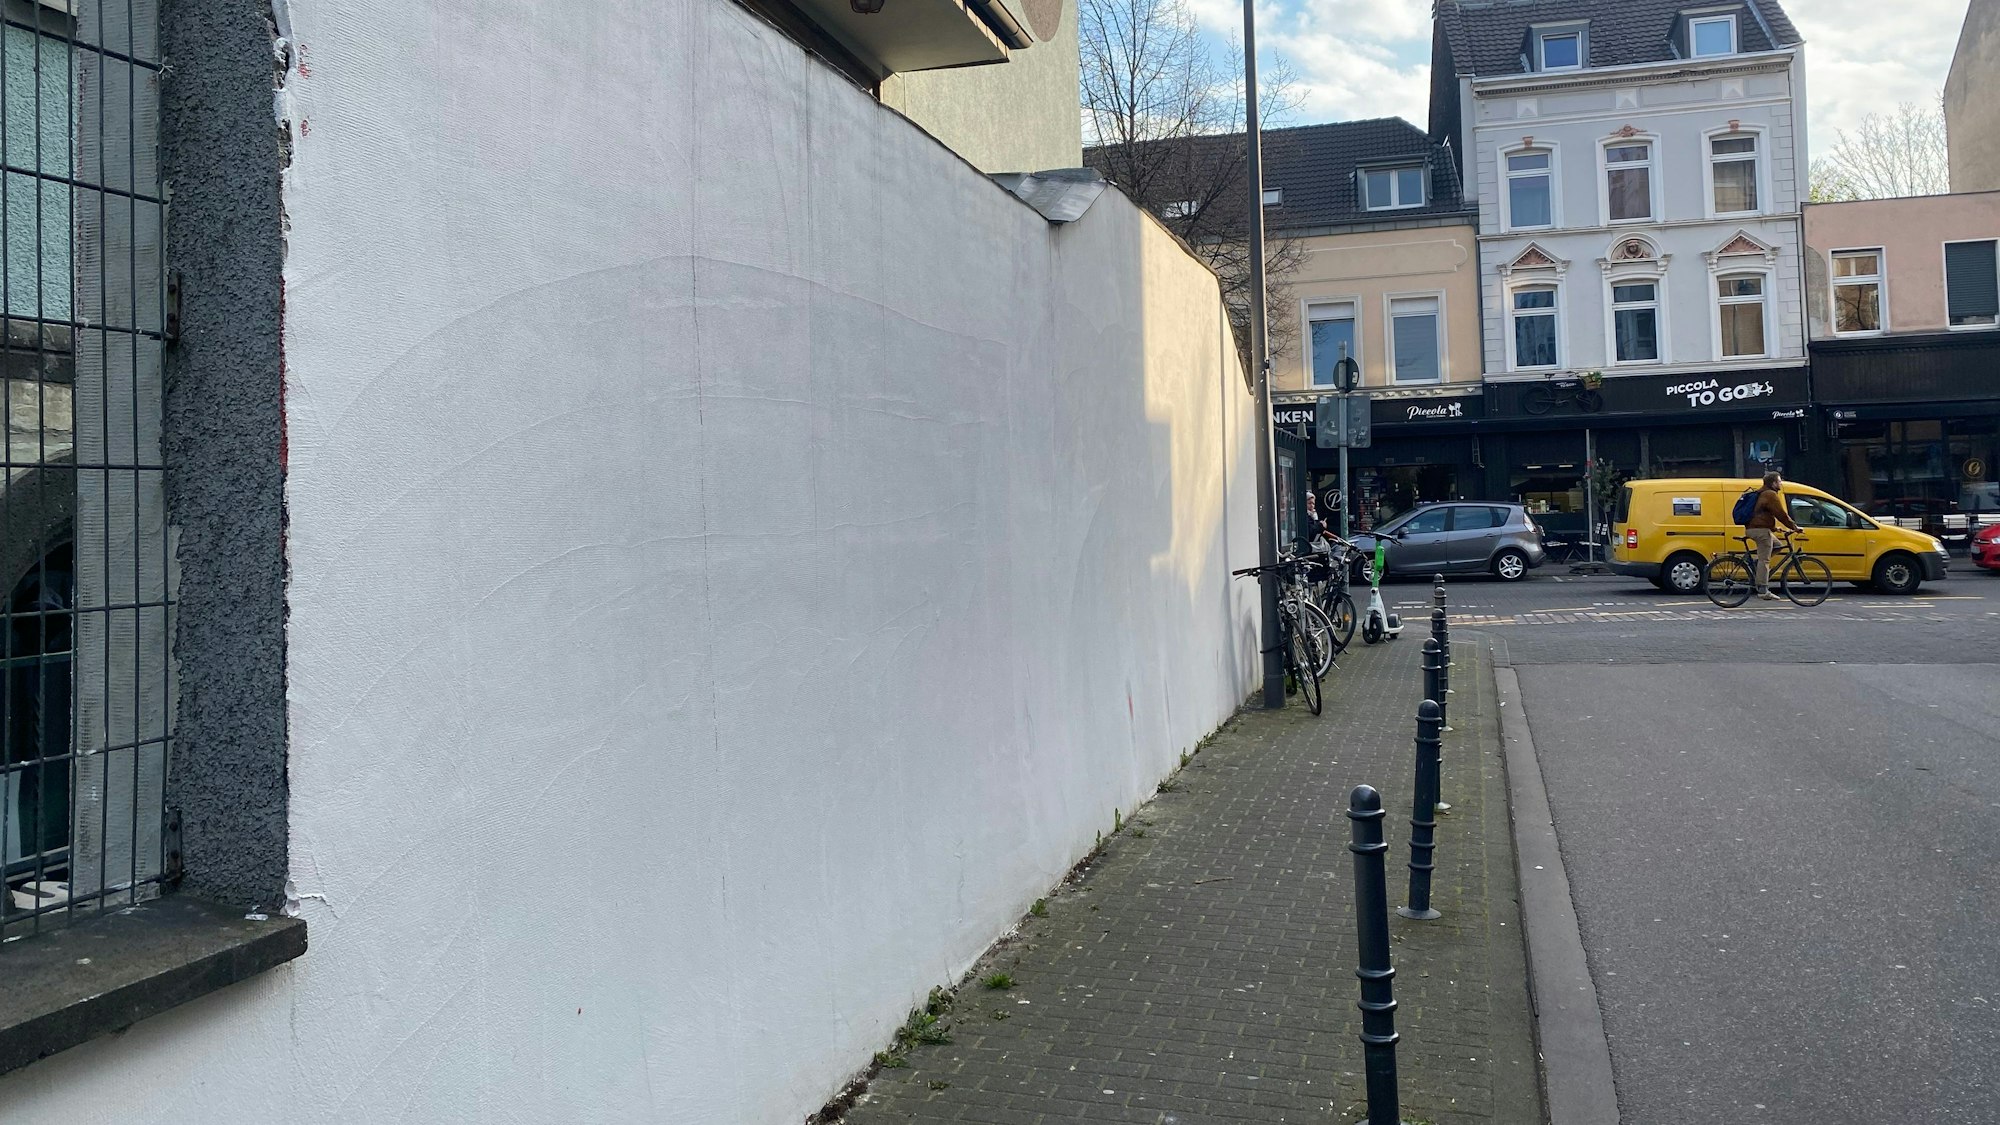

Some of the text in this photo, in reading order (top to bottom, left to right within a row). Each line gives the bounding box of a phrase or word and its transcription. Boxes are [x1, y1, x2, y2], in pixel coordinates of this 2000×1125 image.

[1666, 379, 1719, 395] PICCOLA
[1687, 384, 1750, 407] TO GO
[1406, 404, 1448, 420] Piccola
